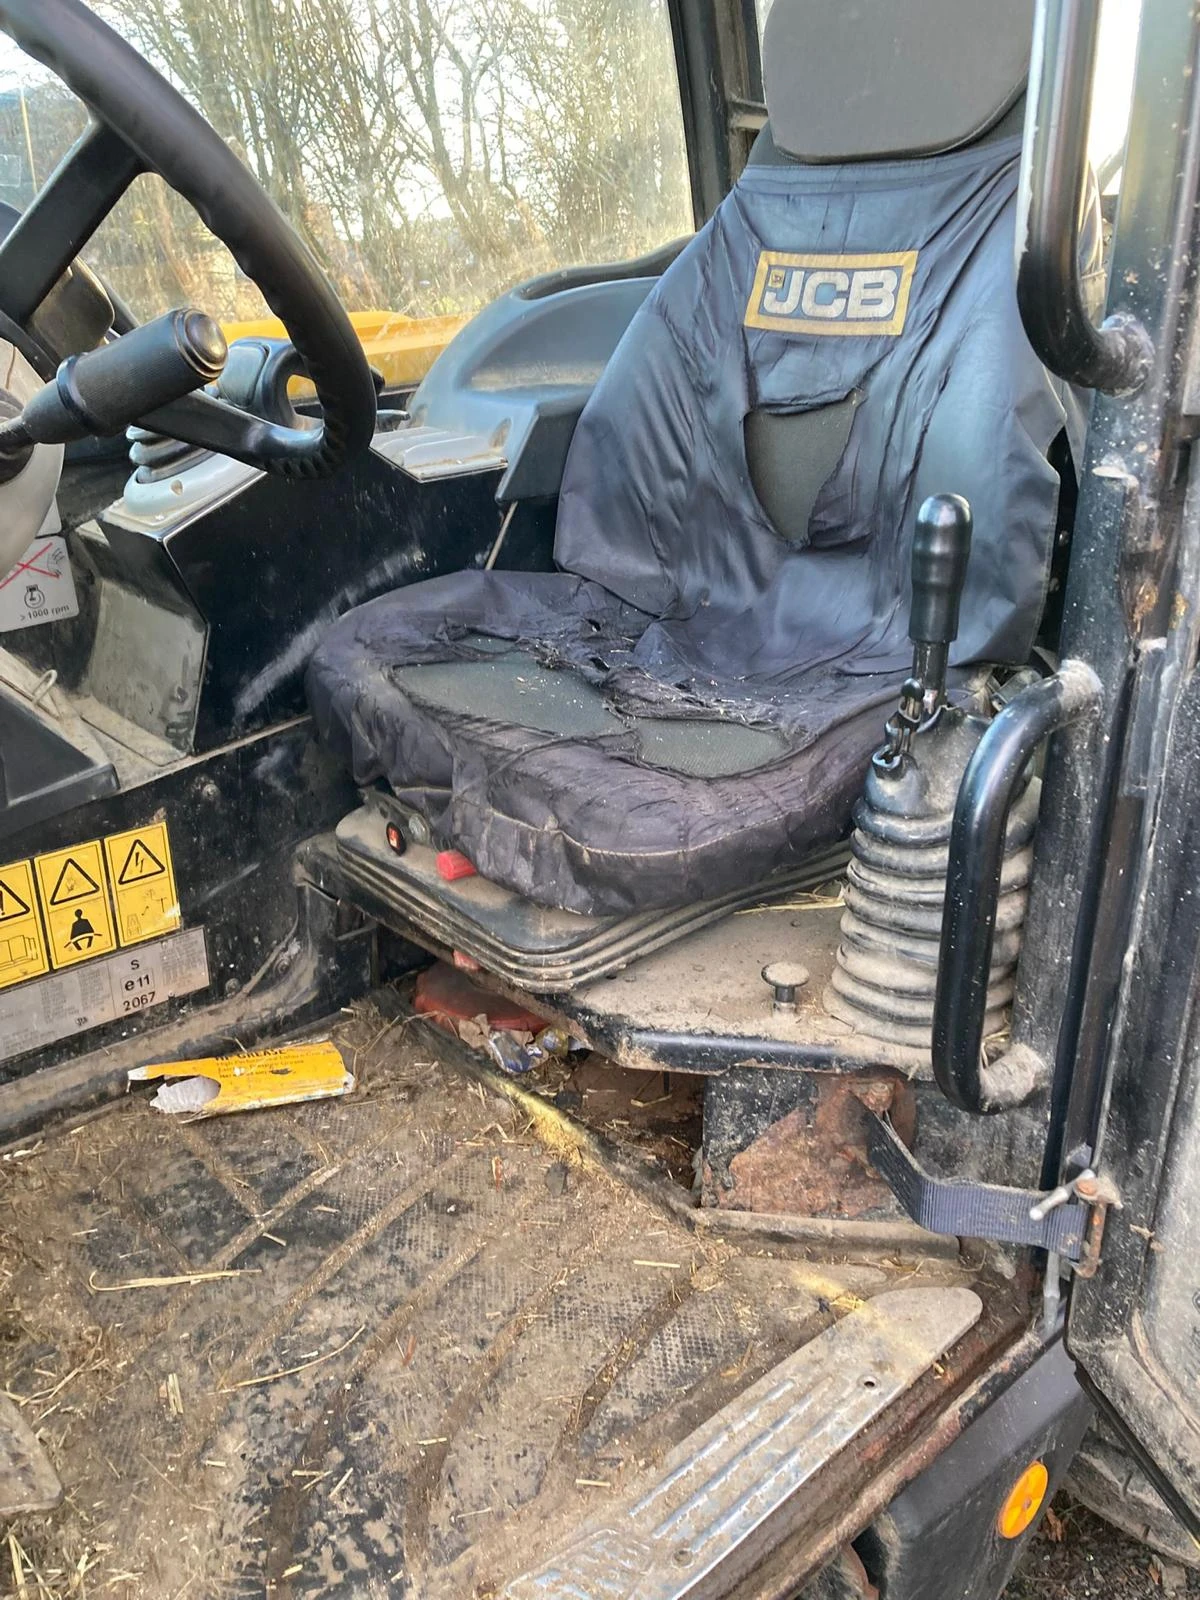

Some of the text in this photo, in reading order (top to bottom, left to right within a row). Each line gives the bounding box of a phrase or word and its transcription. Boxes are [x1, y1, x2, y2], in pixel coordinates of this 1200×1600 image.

[763, 269, 898, 319] JCB
[28, 608, 49, 620] 1000
[51, 605, 70, 616] rpm
[130, 959, 140, 971] S
[122, 991, 157, 1012] 2067
